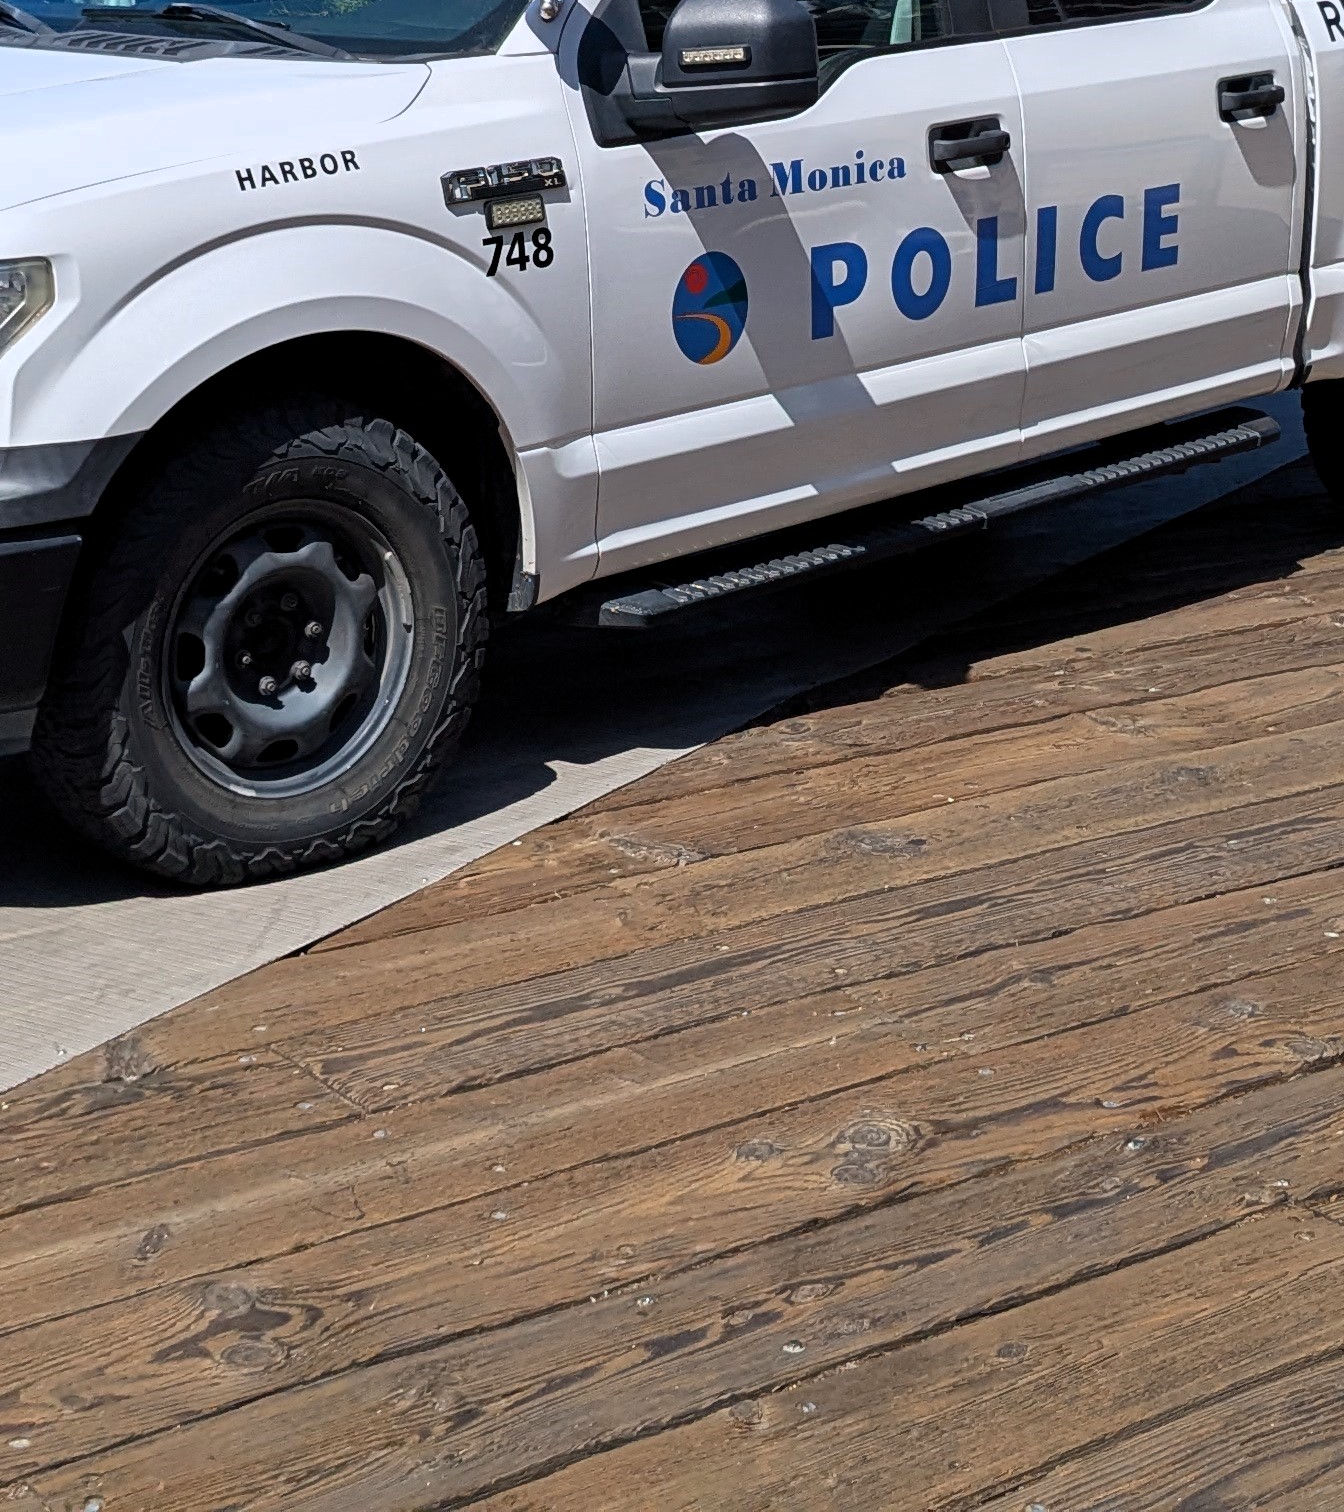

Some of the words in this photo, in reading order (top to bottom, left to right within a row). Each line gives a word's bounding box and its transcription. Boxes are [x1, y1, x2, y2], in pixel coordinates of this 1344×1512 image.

[235, 150, 360, 191] HARBOR
[543, 177, 562, 187] XL
[644, 172, 758, 219] Santa
[769, 149, 907, 198] Monica
[482, 227, 555, 278] 748
[810, 183, 1180, 340] POLICE
[329, 605, 447, 814] BFGoodrich
